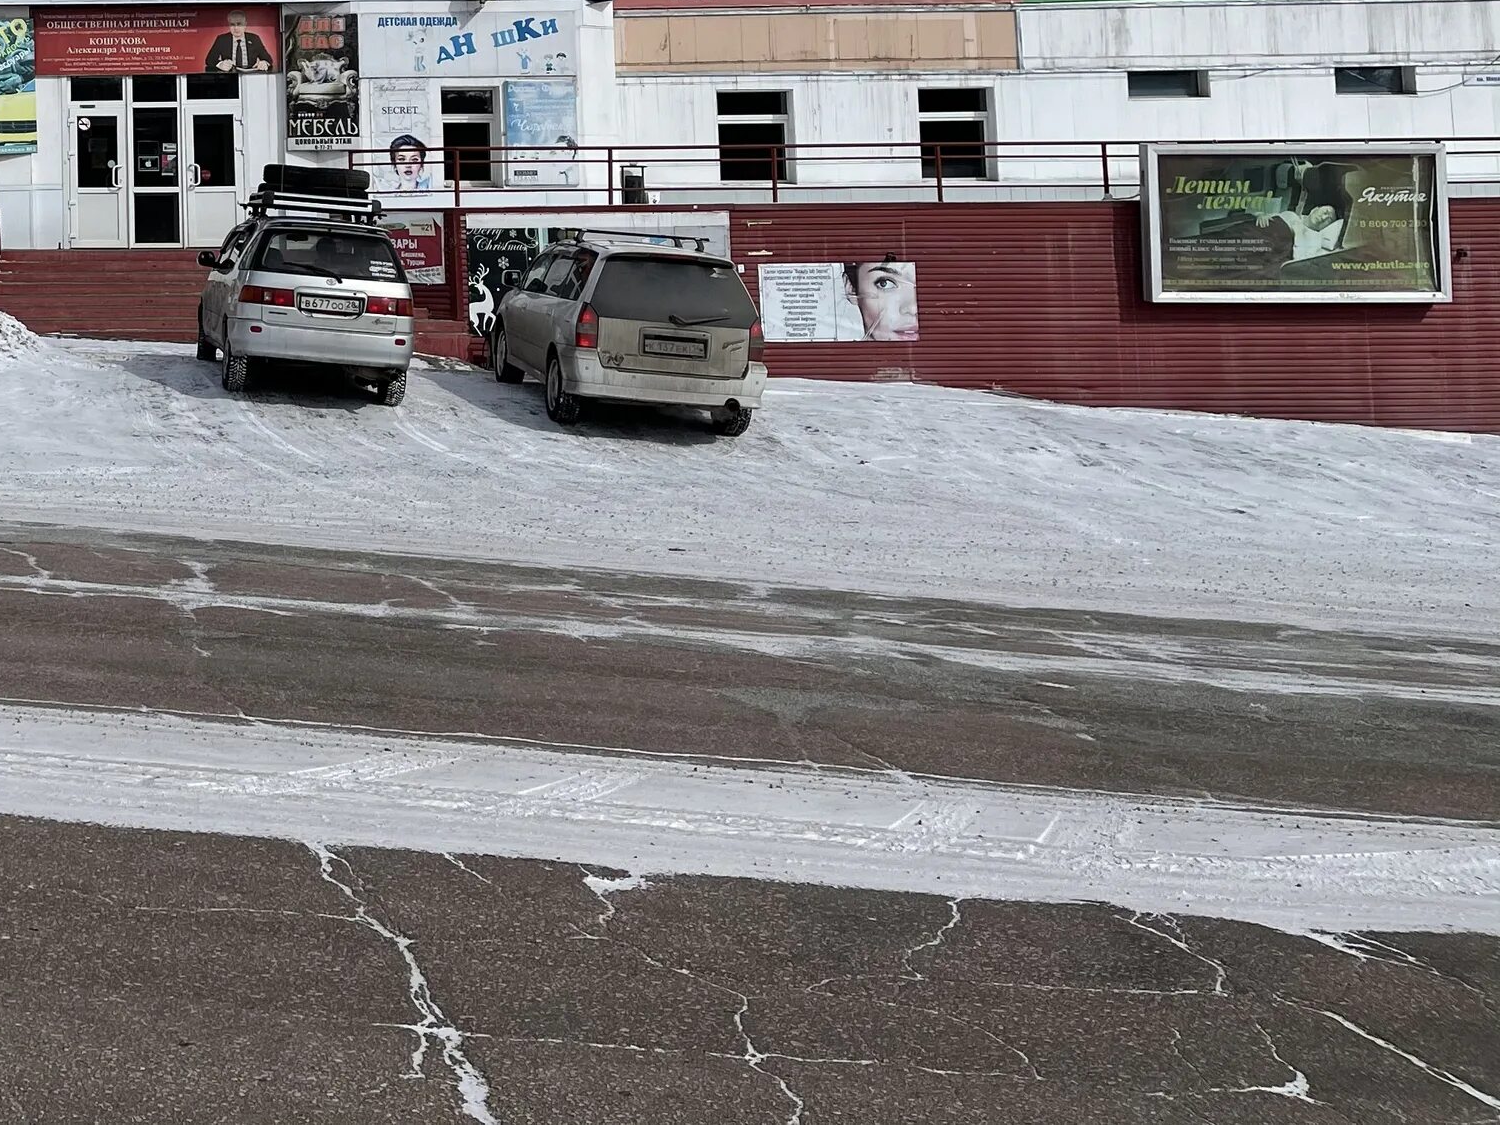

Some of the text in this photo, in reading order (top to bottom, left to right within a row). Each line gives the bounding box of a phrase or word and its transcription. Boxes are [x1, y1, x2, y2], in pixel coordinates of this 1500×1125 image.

[46, 19, 189, 29] ОБЩЕСТВЕННАЯ ПРИЕМНАЯ
[378, 17, 457, 27] ДЕТСКАЯ ОДЕЖДА
[89, 37, 147, 45] КОШУКОВА
[66, 46, 171, 55] Александра Андреевича
[382, 106, 418, 114] SECRET
[289, 118, 358, 135] МЕБЕЛЬ
[1166, 176, 1251, 194] Летим
[1357, 187, 1428, 206] Якутия
[473, 235, 528, 251] Christmas
